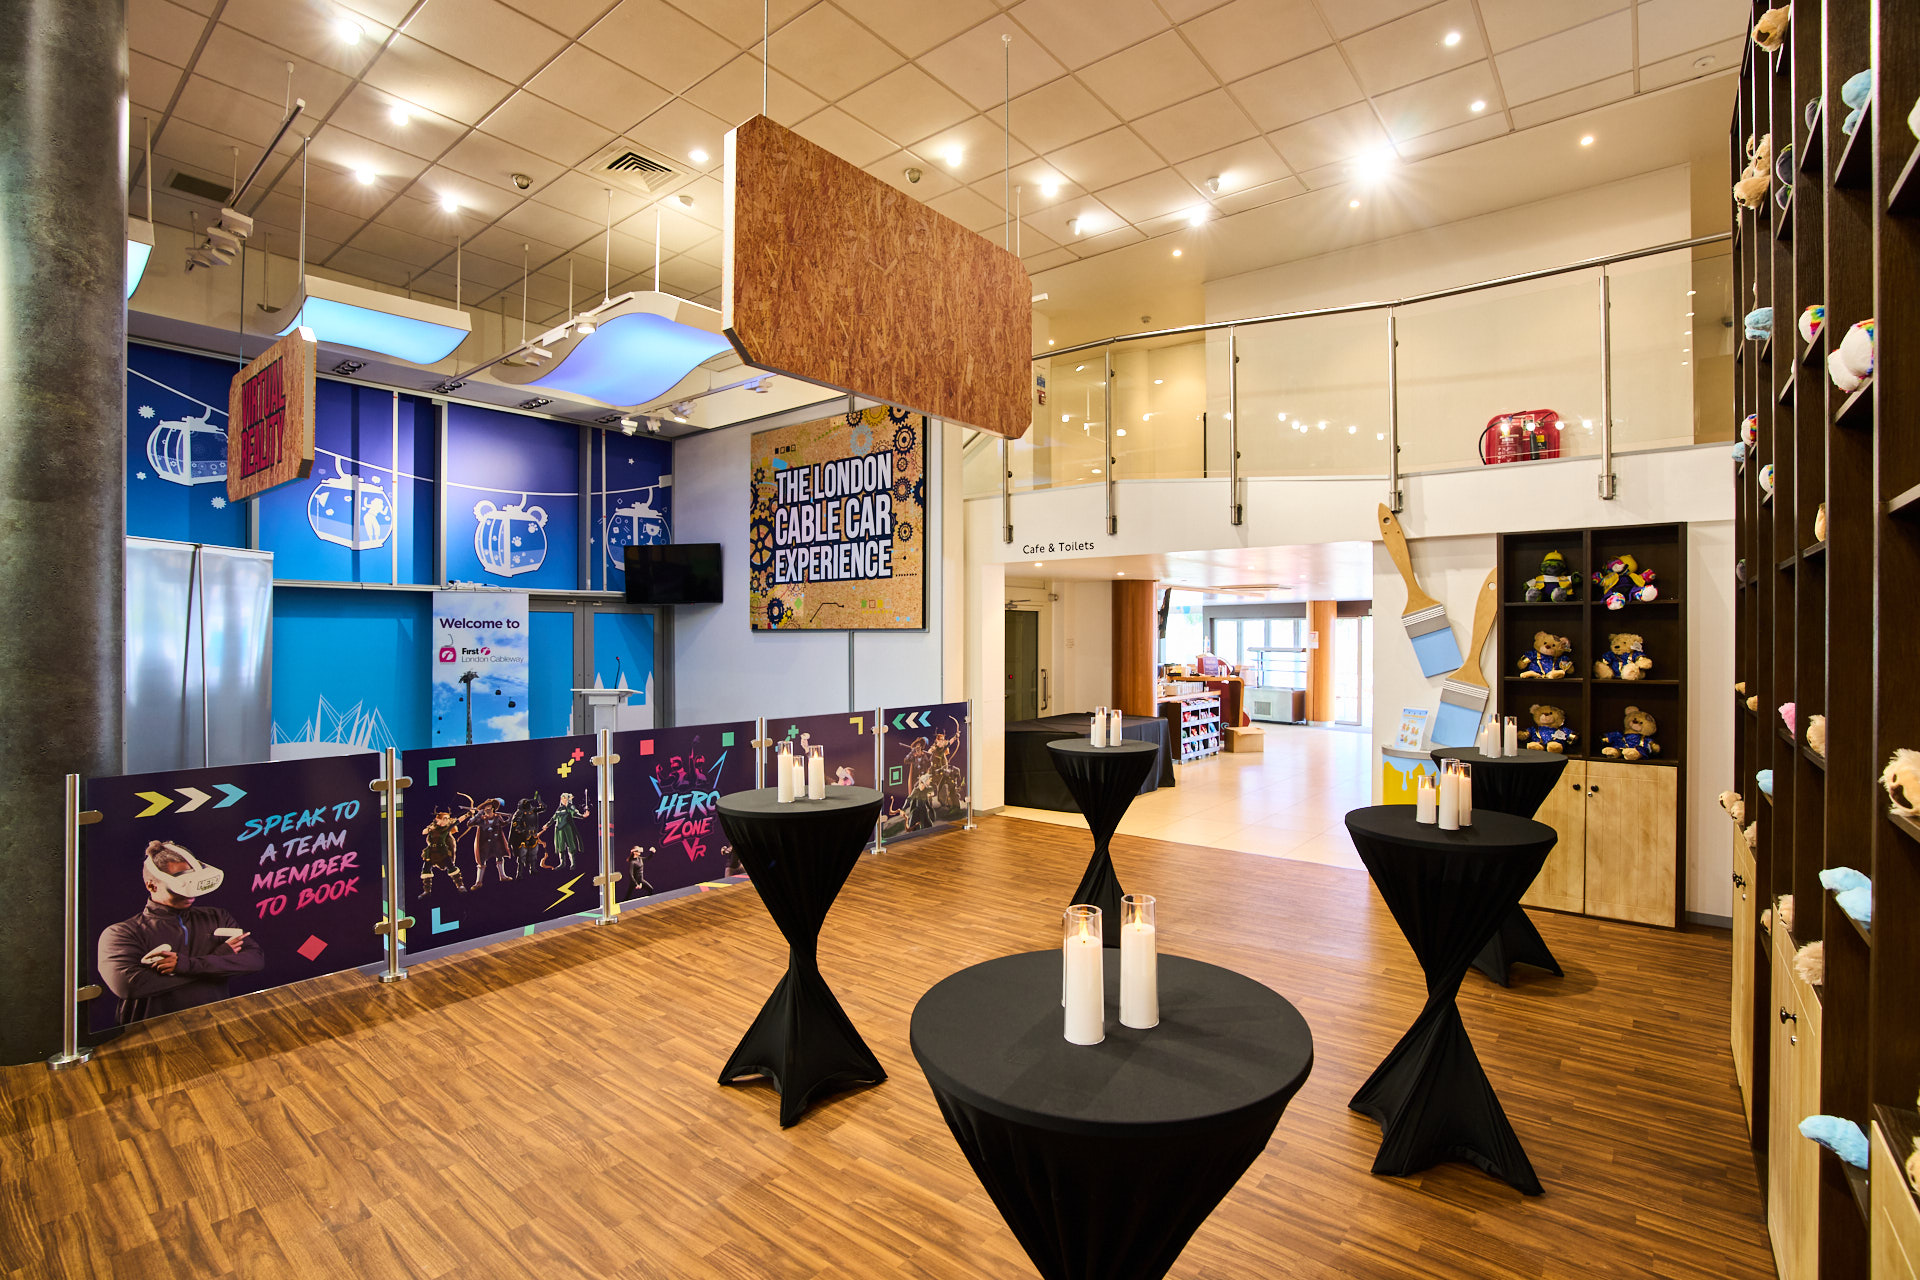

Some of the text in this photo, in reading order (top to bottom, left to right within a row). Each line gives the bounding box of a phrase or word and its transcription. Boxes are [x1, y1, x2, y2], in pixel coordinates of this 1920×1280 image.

[241, 356, 286, 432] VIRTUAL
[240, 407, 286, 480] REALITY
[775, 452, 892, 504] THE LONDON
[775, 493, 891, 546] CABLE CAR
[775, 539, 892, 583] EXPERIENCE
[1022, 541, 1095, 554] Cafe & Toilets
[439, 617, 520, 629] Welcome to
[461, 647, 479, 655] First
[461, 655, 524, 664] London Cableway
[236, 799, 360, 842] SPEAK TO
[655, 790, 720, 820] HERO
[259, 829, 347, 866] A TEAM
[663, 816, 713, 845] ZONE
[682, 837, 707, 862] VR
[251, 851, 360, 892] MEMBER
[255, 876, 360, 919] TO BOOK
